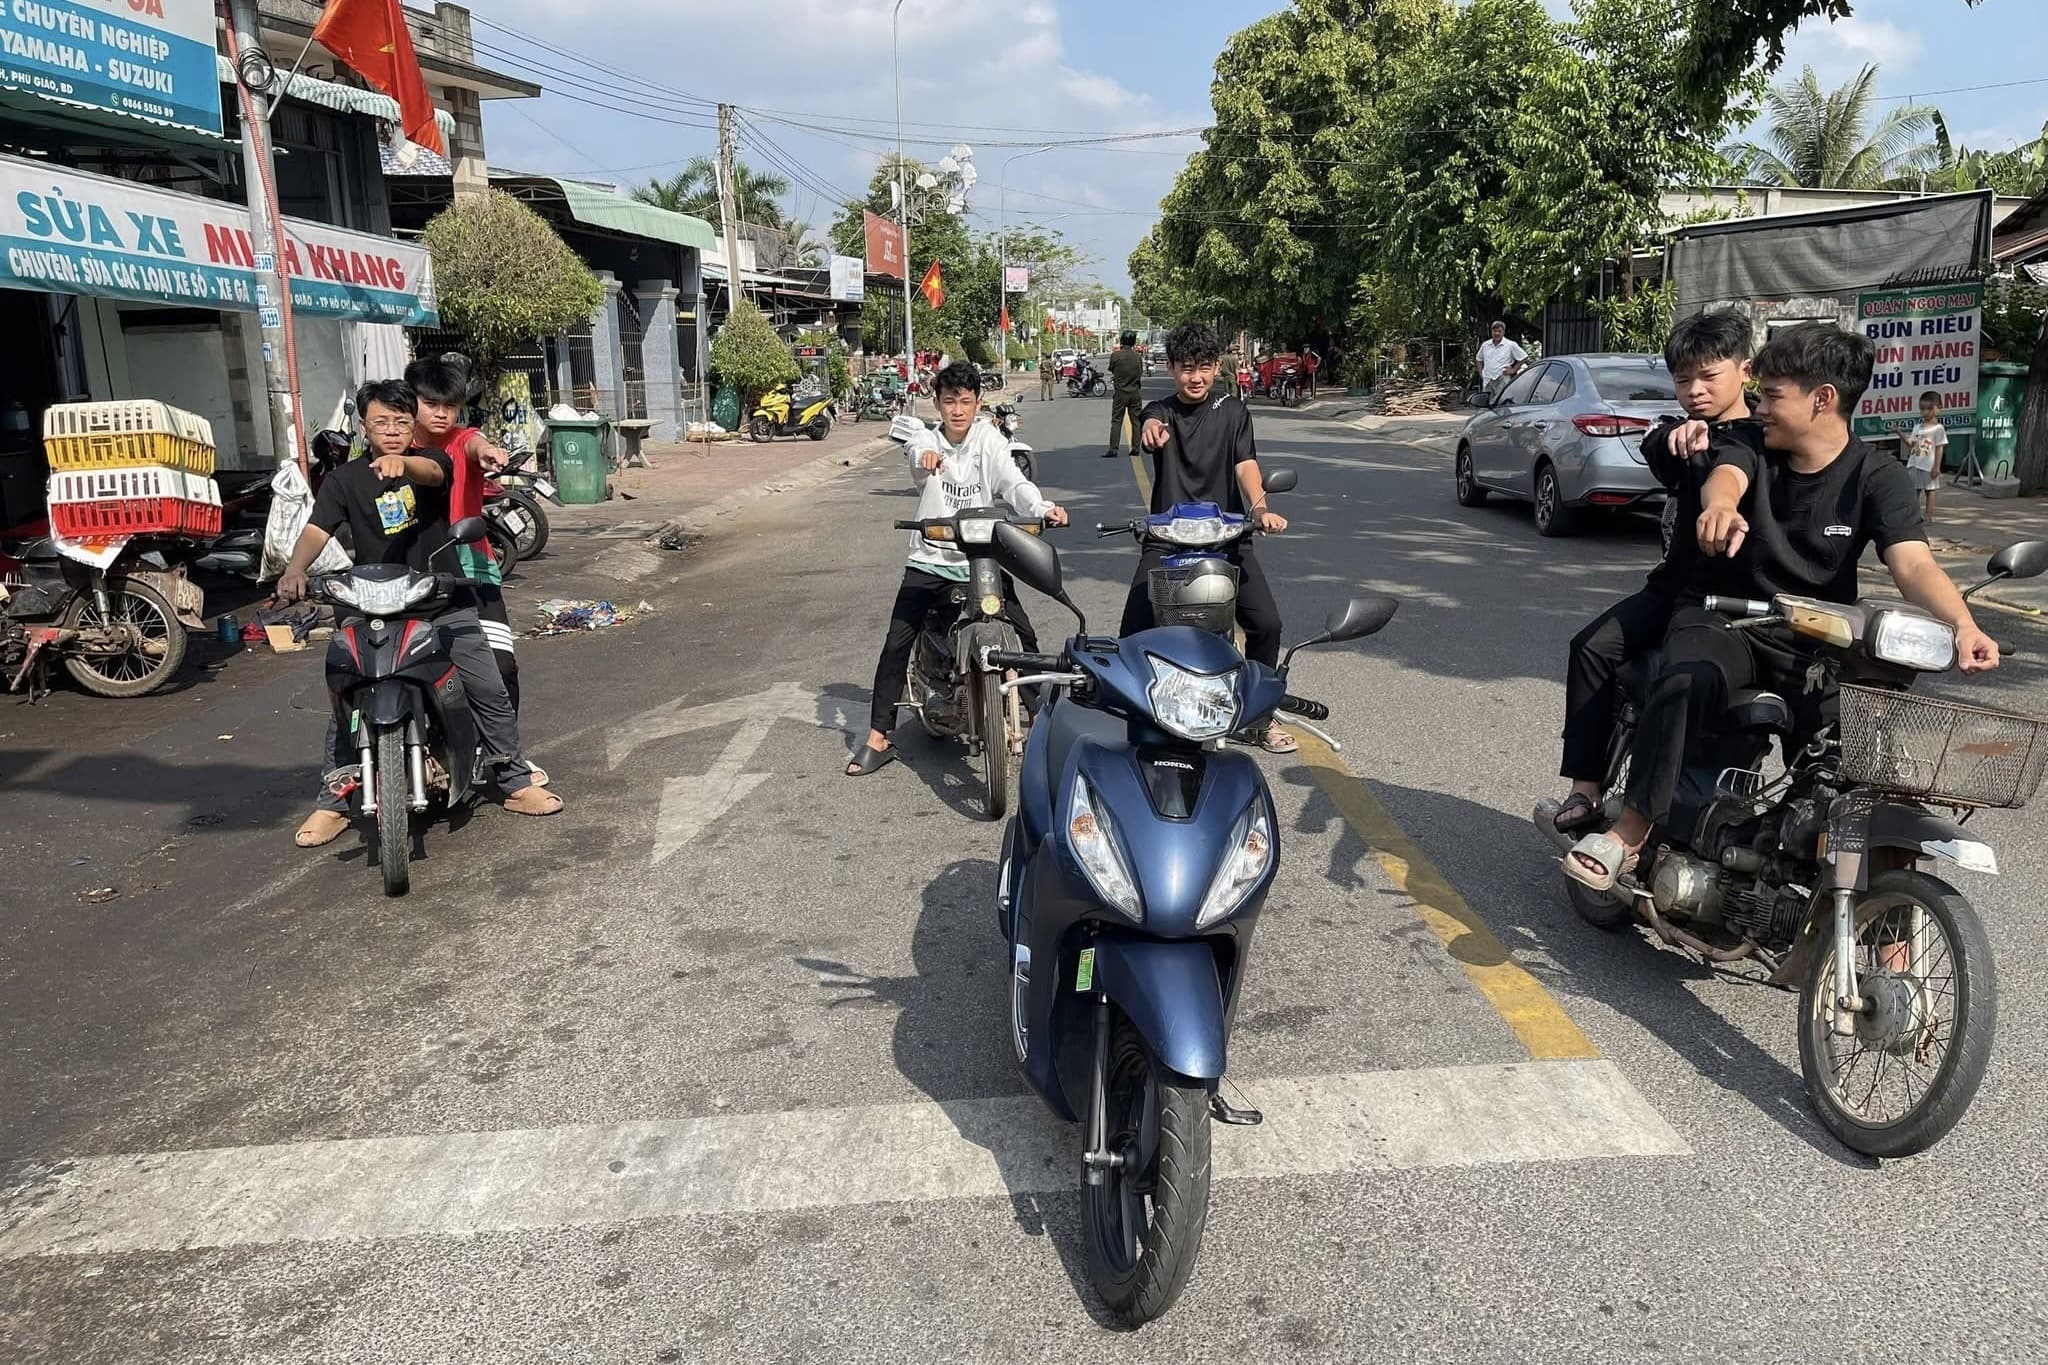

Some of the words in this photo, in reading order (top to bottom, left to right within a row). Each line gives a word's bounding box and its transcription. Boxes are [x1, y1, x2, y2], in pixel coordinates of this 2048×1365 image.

[12, 0, 95, 41] CHUYÊN
[101, 24, 170, 64] NGHIỆP
[0, 28, 89, 73] YAMAHA
[108, 58, 173, 95] SUZUKI
[11, 71, 31, 84] PHÚ
[33, 76, 58, 93] GIÁO,
[60, 82, 73, 94] BD
[122, 97, 142, 110] 0866
[17, 186, 125, 248] SỬA
[125, 211, 186, 258] XE
[204, 223, 304, 276] MIH
[306, 243, 405, 290] KHANG
[9, 247, 80, 283] CHUYÊN:
[112, 257, 140, 290] CÁC
[140, 266, 173, 299] LOẠI
[172, 271, 190, 296] XE
[190, 266, 208, 298] SỐ
[216, 276, 232, 300] XE
[234, 278, 250, 302] GA
[1864, 297, 1904, 318] QUÁN
[1906, 295, 1946, 313] NGỌC
[1948, 292, 1976, 308] MAI
[1866, 319, 1912, 339] BÚN
[1920, 314, 1972, 335] RIÊU
[1875, 345, 1905, 364] ÚN
[1912, 340, 1974, 361] MĂNG
[1911, 362, 1961, 386] TIẾU
[1861, 395, 1913, 415] BÁNH
[942, 480, 981, 497] mirates
[1153, 760, 1195, 770] HONDA
